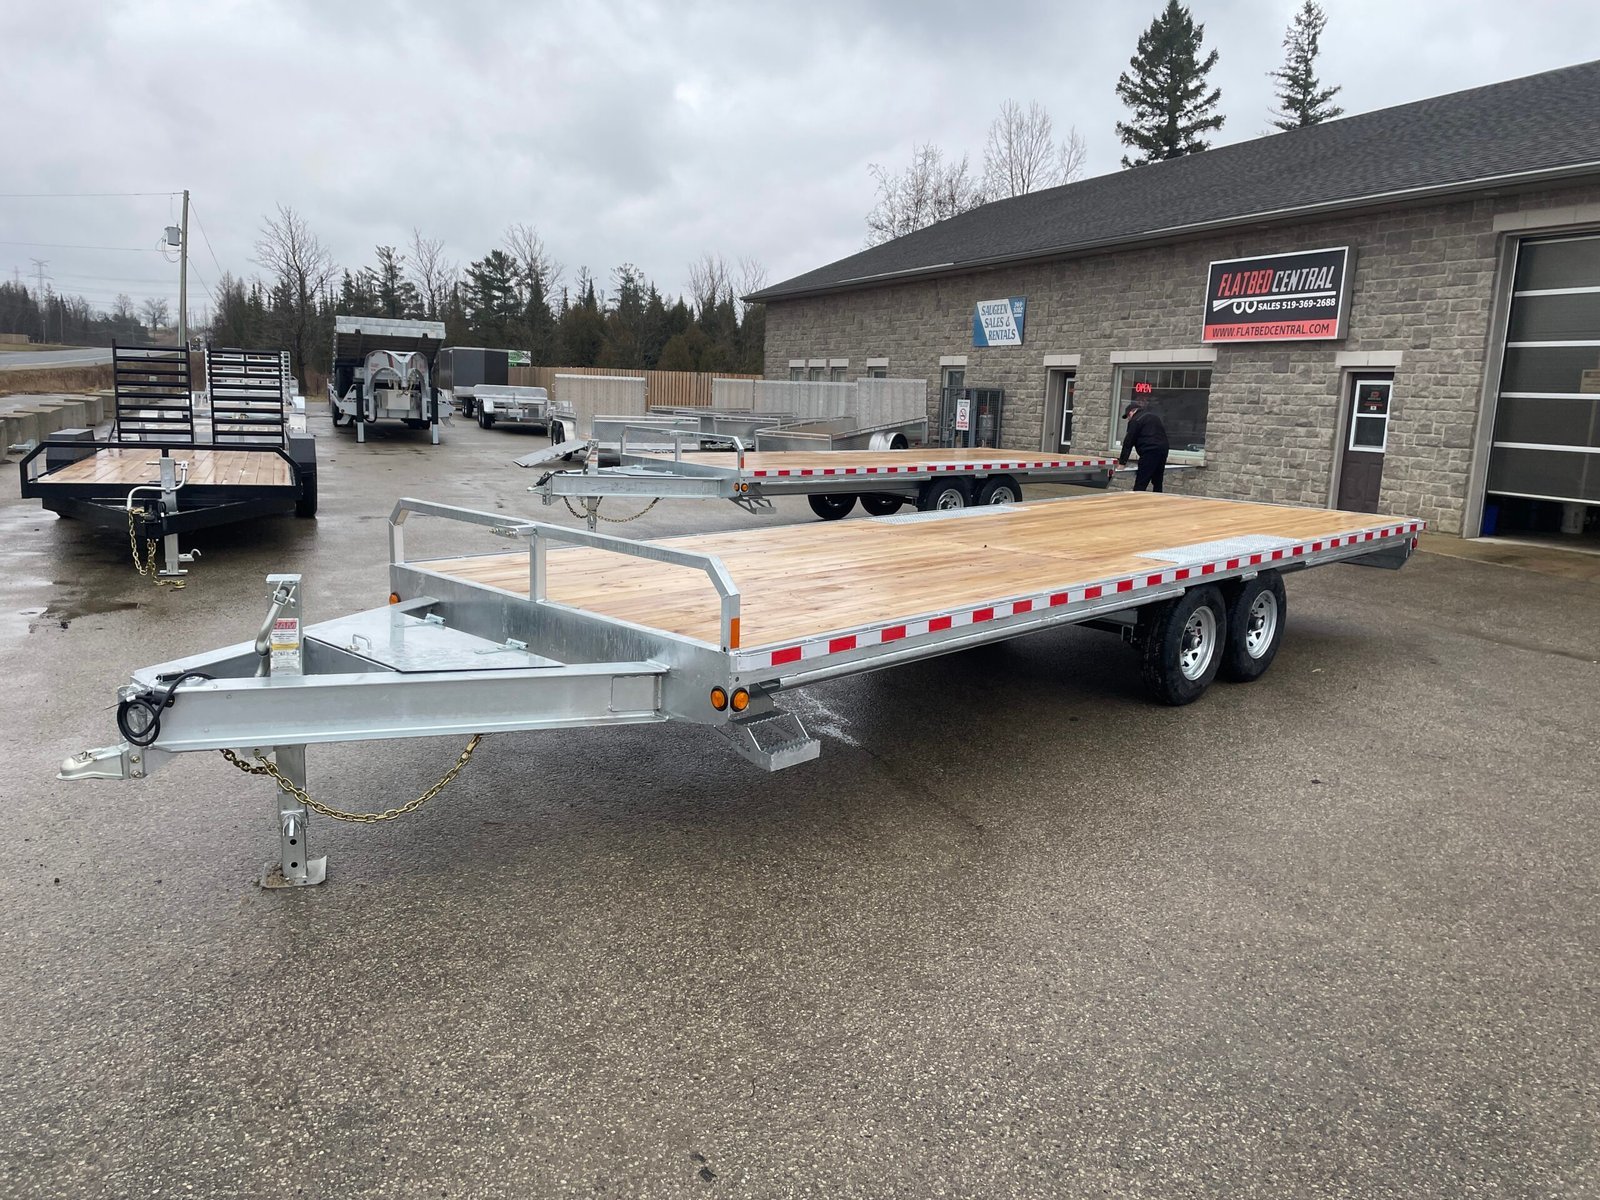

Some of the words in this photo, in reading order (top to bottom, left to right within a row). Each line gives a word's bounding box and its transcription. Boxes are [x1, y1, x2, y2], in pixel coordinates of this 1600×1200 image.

[1218, 269, 1274, 297] FLATBED
[1272, 266, 1335, 292] CENTRAL
[1258, 302, 1281, 311] SALES
[1282, 298, 1336, 309] 519-369-2688
[984, 317, 1004, 328] SALES
[988, 329, 1016, 341] RENTALS
[1212, 323, 1330, 337] WWW.FLATBEDCENTRAL.COM
[1136, 382, 1152, 393] OPEN
